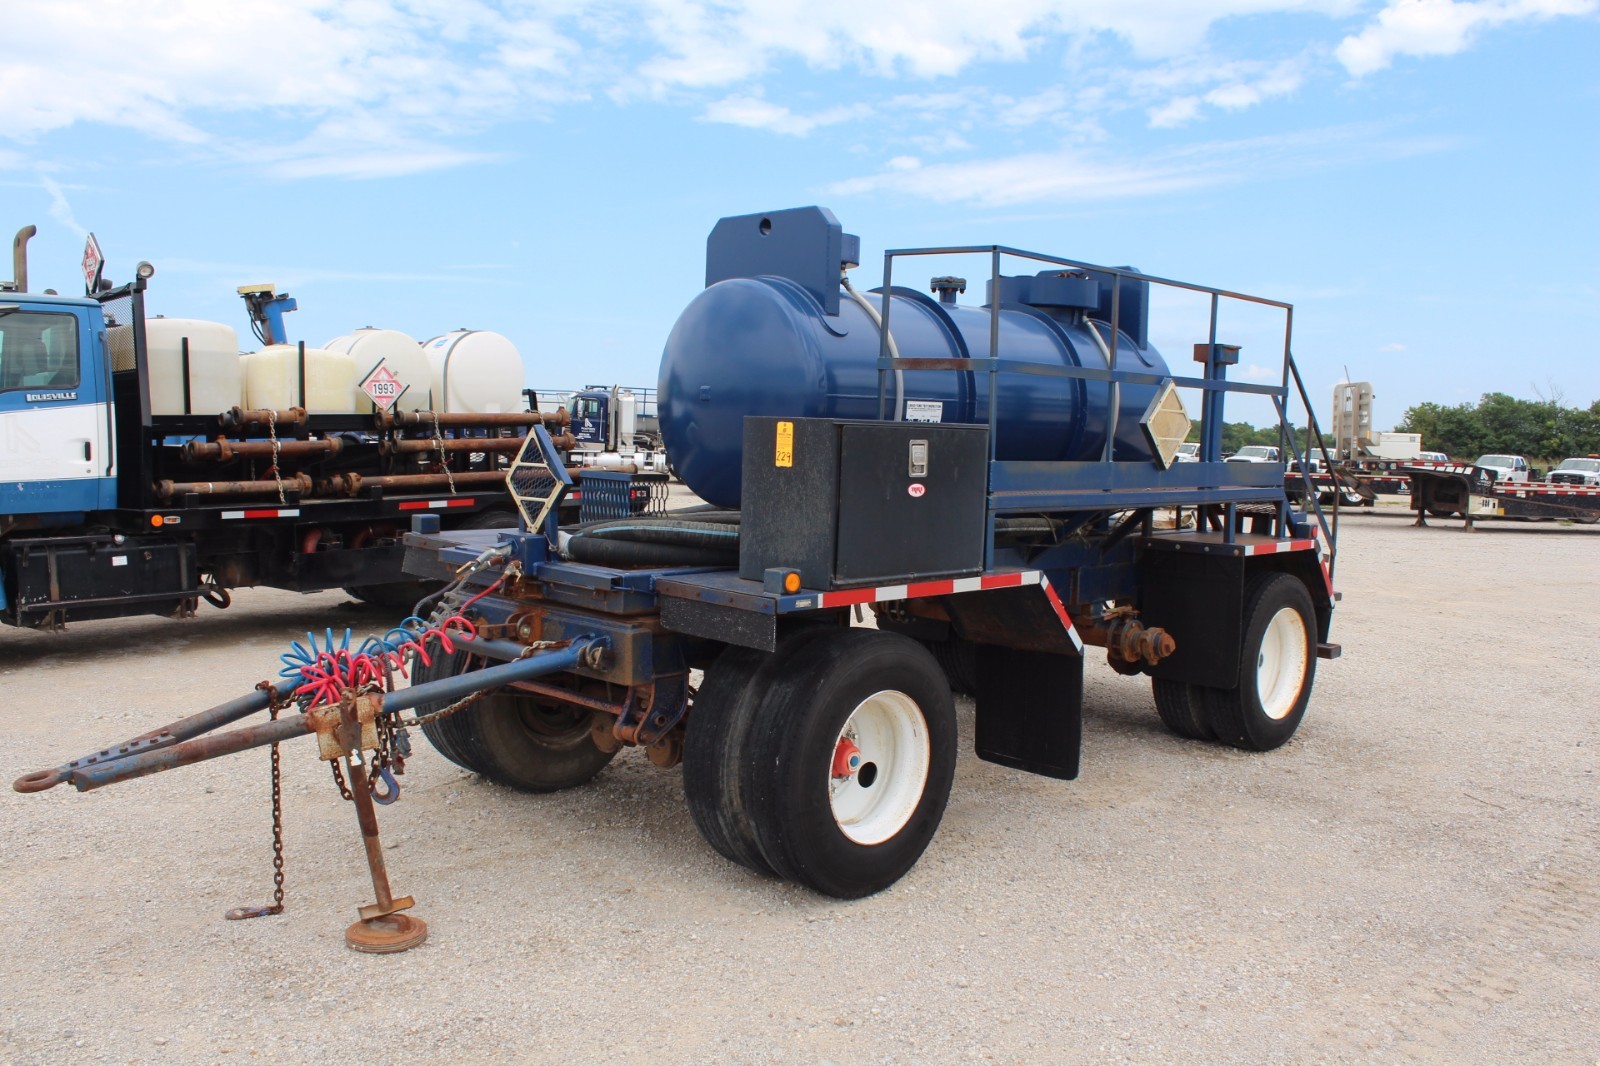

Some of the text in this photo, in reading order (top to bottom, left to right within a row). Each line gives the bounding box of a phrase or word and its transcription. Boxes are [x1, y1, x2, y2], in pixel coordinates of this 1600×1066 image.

[373, 383, 394, 394] 1993
[26, 392, 77, 402] LOUISVILLE
[776, 450, 791, 463] 229
